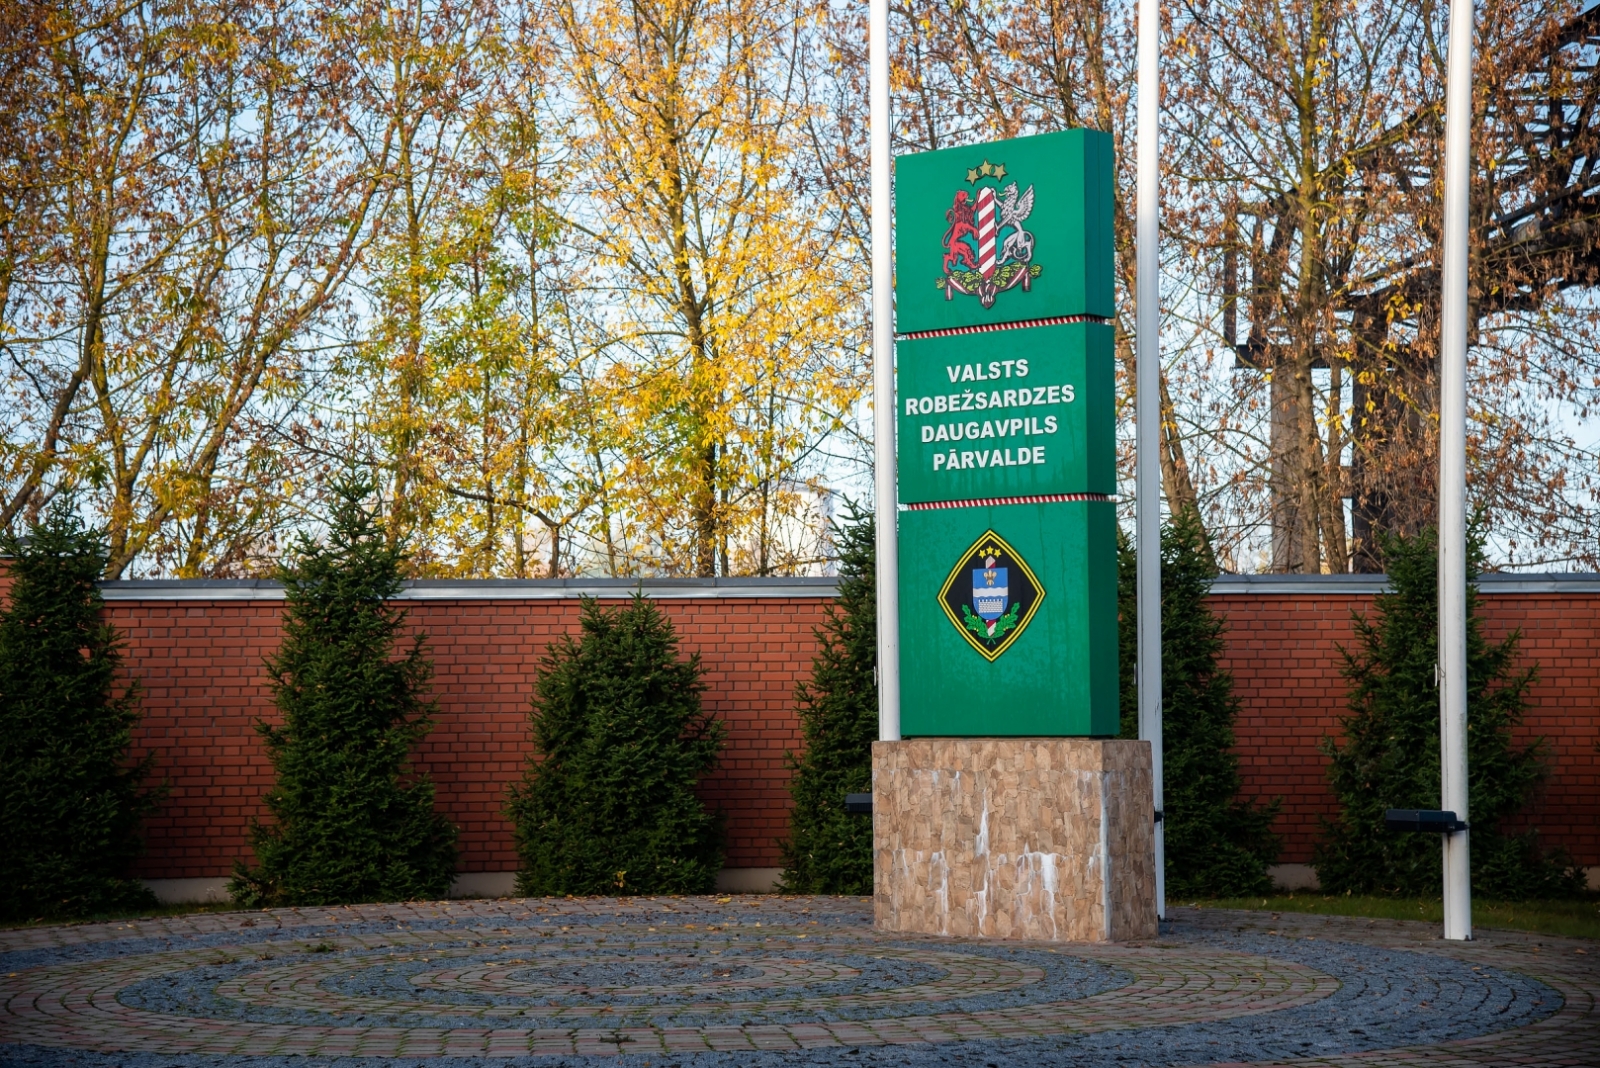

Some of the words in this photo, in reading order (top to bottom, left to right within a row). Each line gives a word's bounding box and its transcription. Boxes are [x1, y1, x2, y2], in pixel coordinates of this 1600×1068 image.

[946, 358, 1029, 383] VALSTS
[905, 384, 1075, 416] ROBEŽSARDZES
[921, 415, 1058, 443] DAUGAVPILS
[933, 445, 1046, 471] PĀRVALDE
